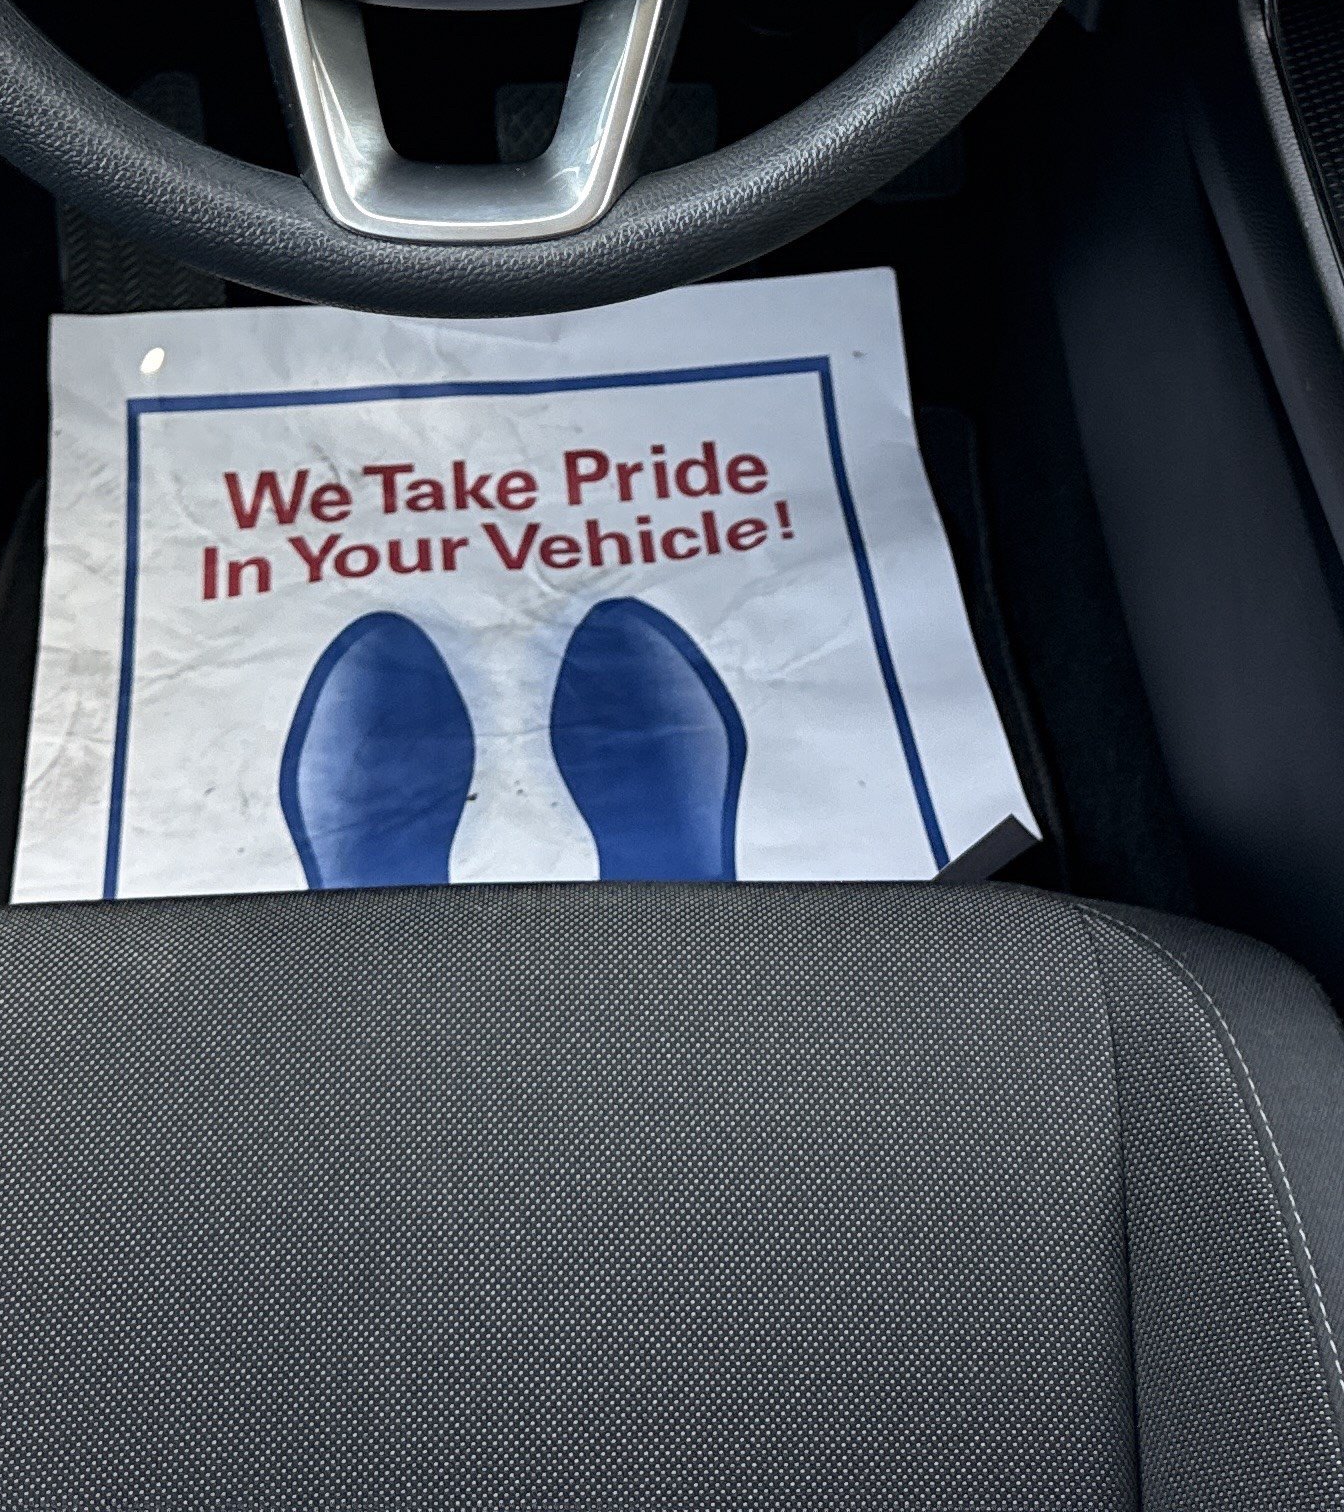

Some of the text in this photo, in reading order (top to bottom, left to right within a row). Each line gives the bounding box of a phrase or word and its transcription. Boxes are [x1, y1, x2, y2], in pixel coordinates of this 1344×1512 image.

[224, 440, 771, 530] We Take Pride
[201, 501, 795, 601] In Your Vehicle!
